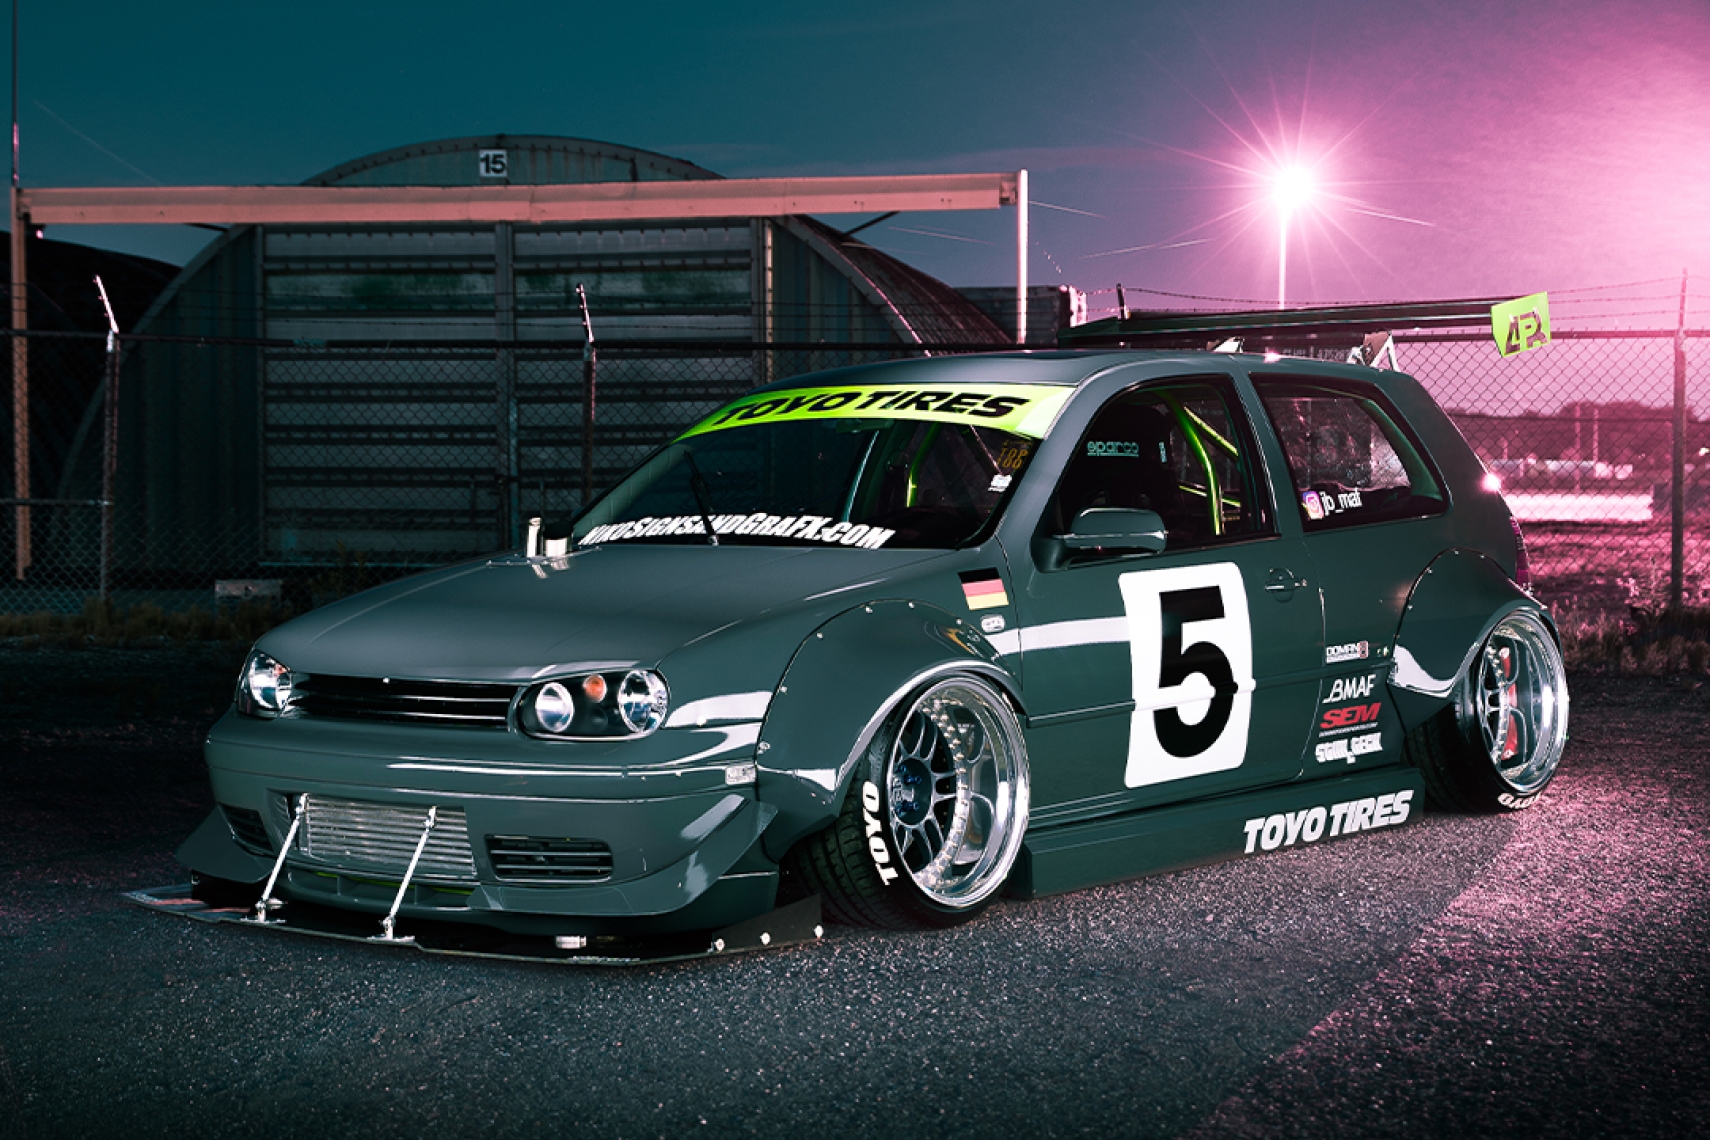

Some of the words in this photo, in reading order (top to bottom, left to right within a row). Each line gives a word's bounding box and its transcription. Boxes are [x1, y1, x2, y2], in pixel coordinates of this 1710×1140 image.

[480, 153, 506, 174] 15
[712, 392, 857, 426] TOYO
[855, 390, 1032, 418] TIRES
[1087, 441, 1139, 456] sparco
[1153, 585, 1239, 758] 5
[1322, 673, 1376, 703] BMAF
[1320, 702, 1381, 729] SEM
[862, 780, 898, 886] TOYO
[1243, 806, 1327, 854] TOYO
[1330, 789, 1414, 837] TIRES
